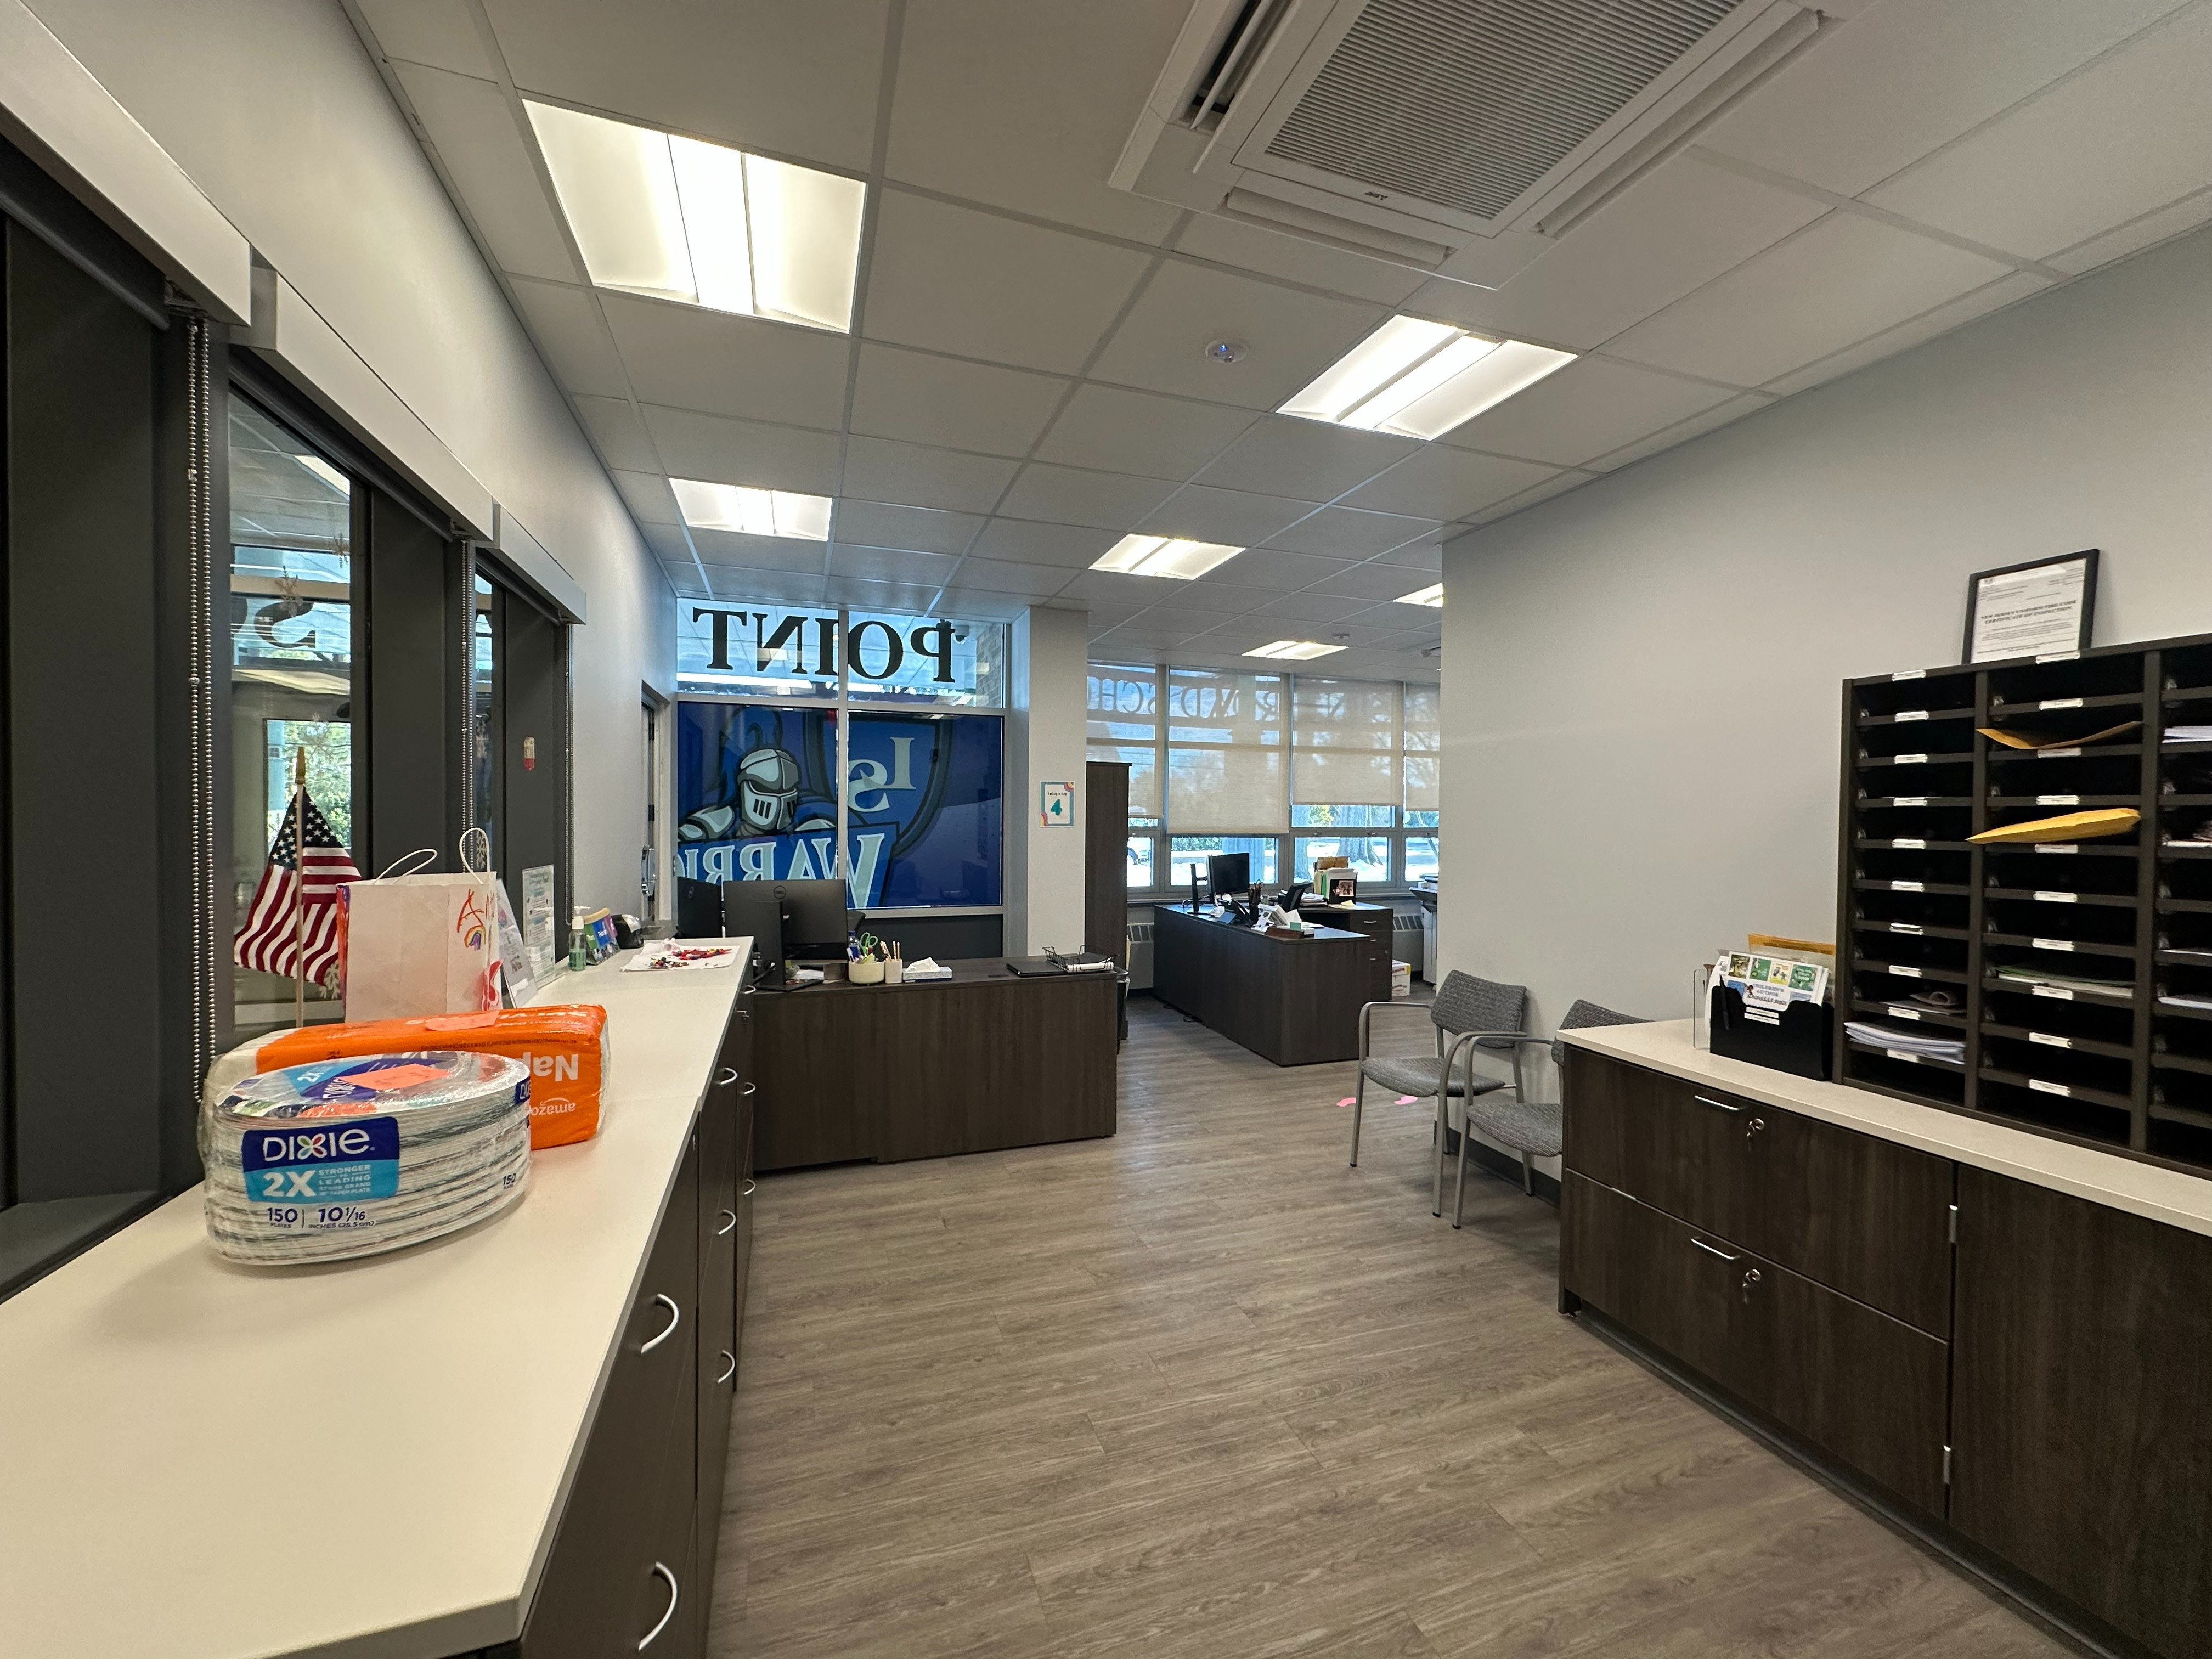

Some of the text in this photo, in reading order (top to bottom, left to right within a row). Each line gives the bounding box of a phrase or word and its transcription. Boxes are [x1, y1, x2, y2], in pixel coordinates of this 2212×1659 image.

[1050, 798, 1063, 816] 4
[530, 1102, 577, 1116] amazo
[318, 1164, 371, 1176] STRONGER
[262, 1170, 317, 1197] 2X
[318, 1175, 371, 1186] LEADING
[503, 1172, 516, 1186] 150
[267, 1207, 298, 1223] 150
[318, 1206, 343, 1223] 10
